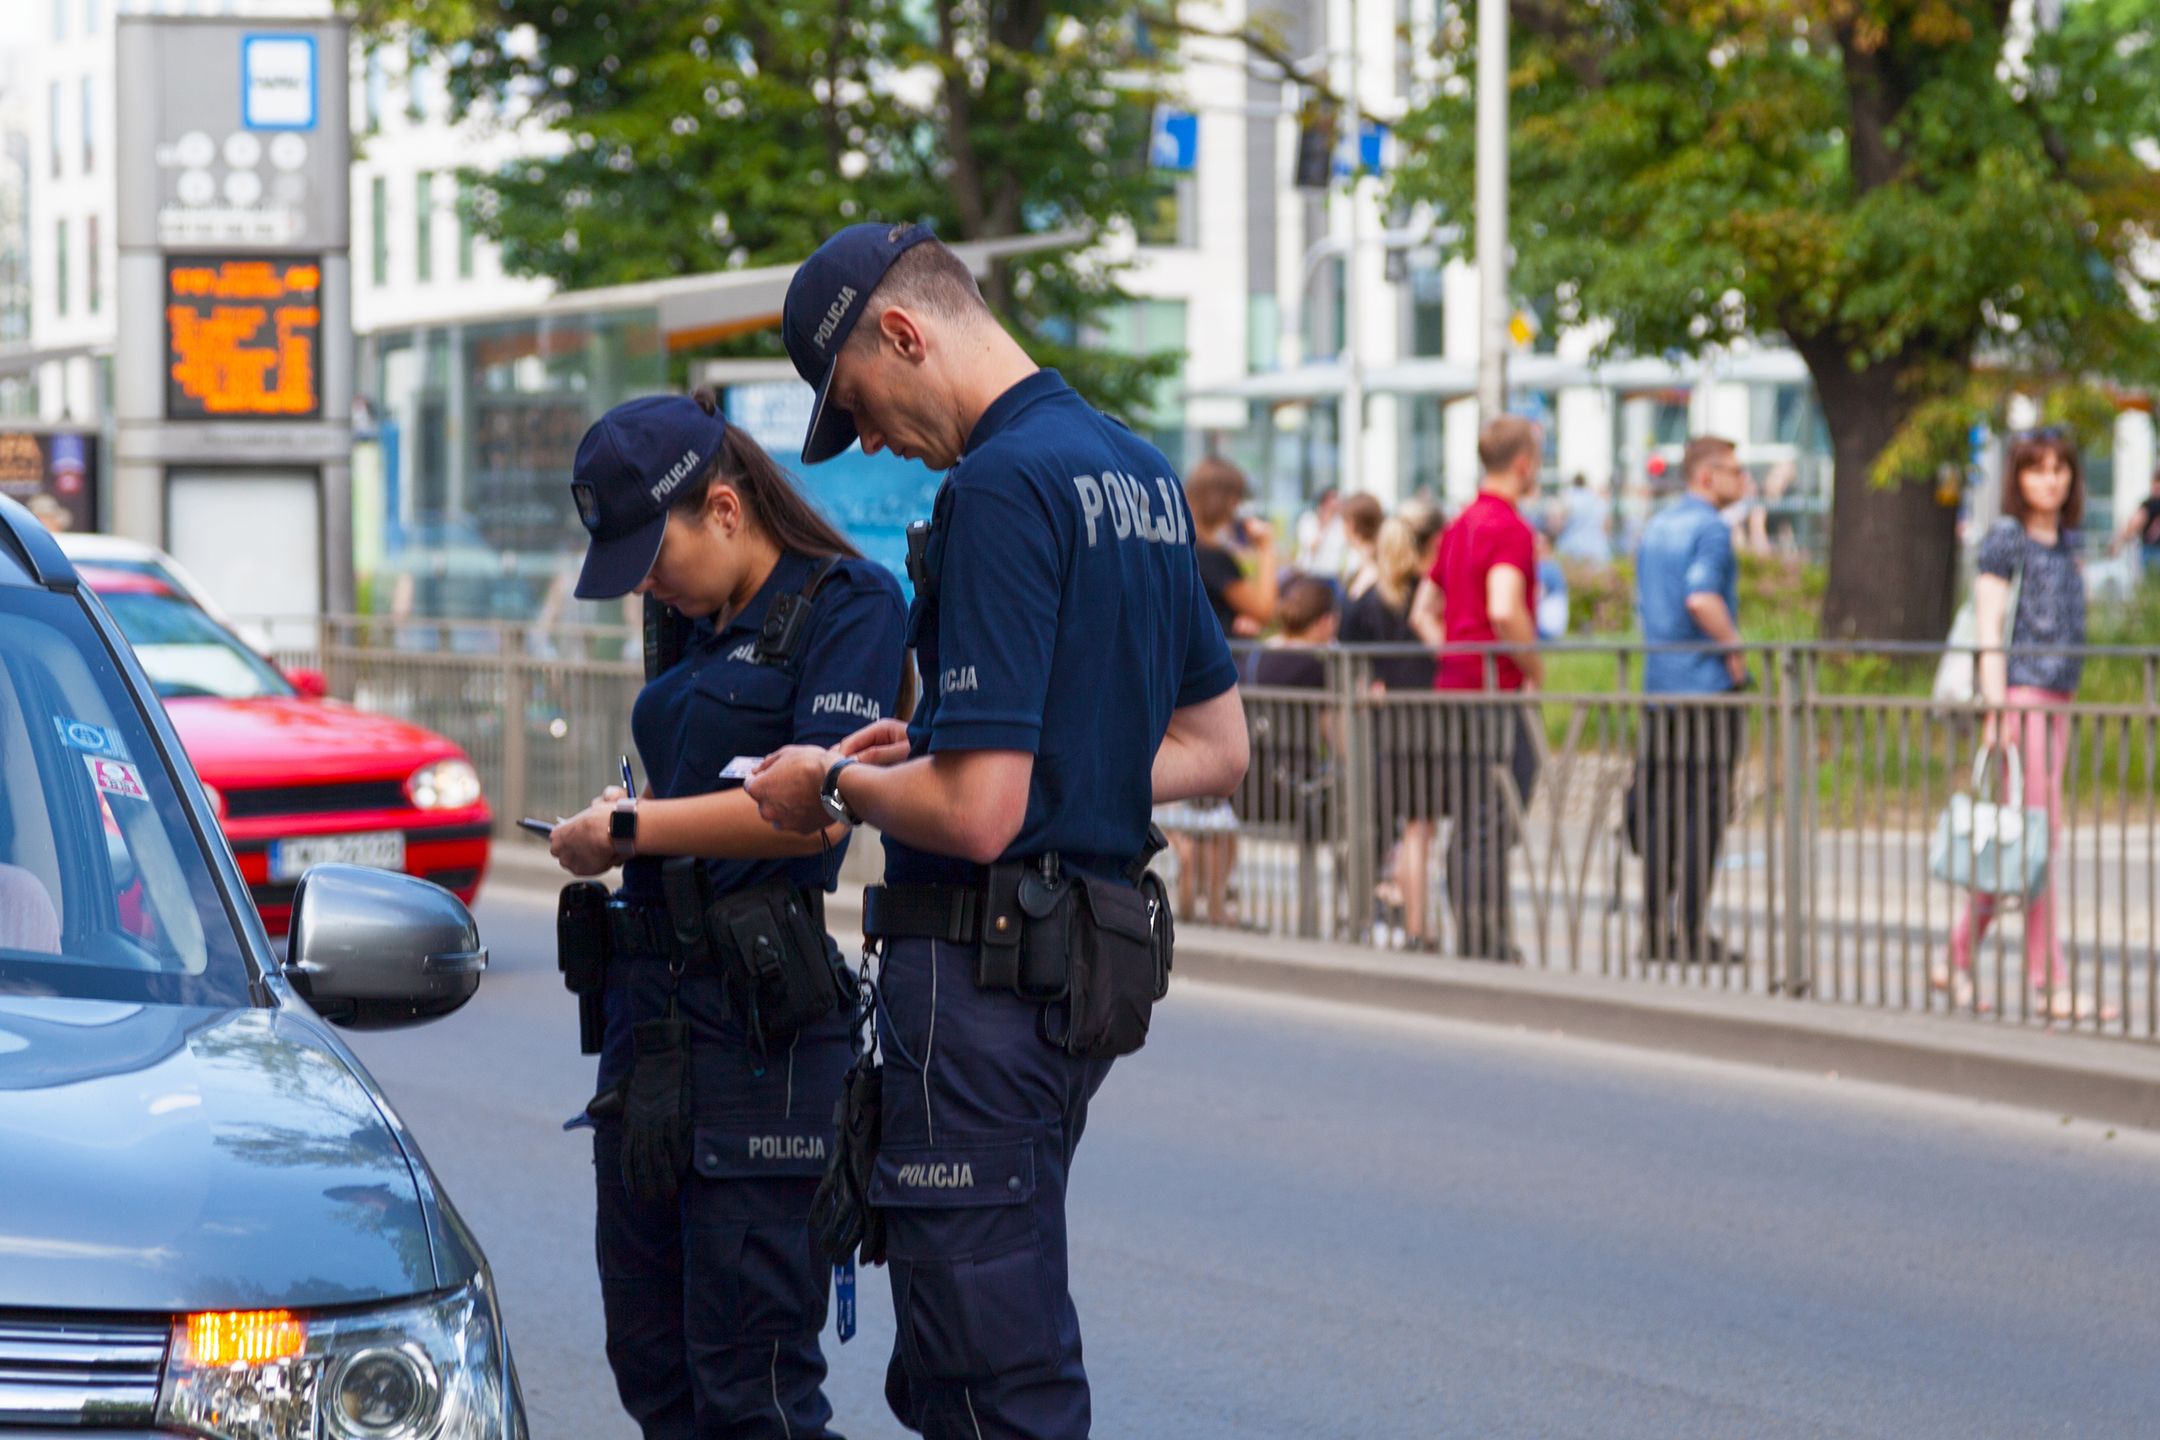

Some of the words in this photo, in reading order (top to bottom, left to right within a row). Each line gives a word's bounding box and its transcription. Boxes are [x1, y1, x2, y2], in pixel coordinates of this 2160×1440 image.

[813, 285, 857, 349] POLICJA
[651, 449, 700, 503] POLICJA
[812, 691, 880, 721] POLICJA
[749, 1136, 825, 1159] POLICJA
[898, 1162, 974, 1188] POLICJA
